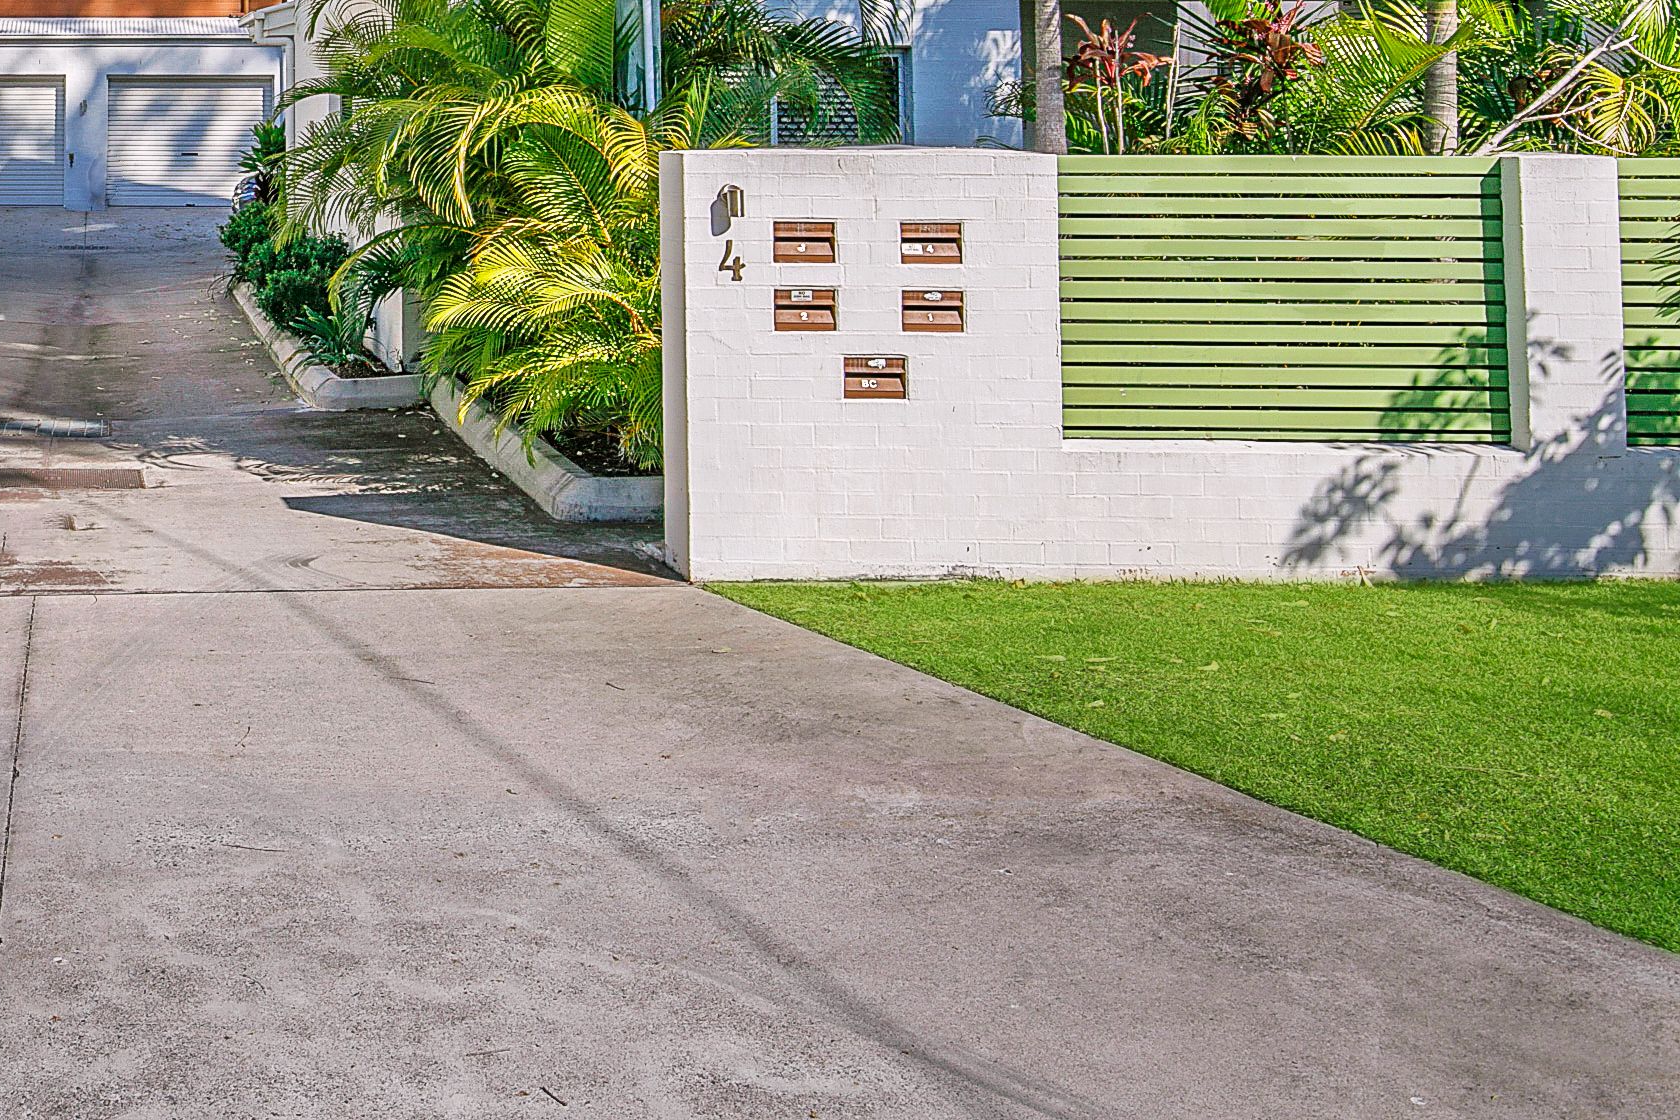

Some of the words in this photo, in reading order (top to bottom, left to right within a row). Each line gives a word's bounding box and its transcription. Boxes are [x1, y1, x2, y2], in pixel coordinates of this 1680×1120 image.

[926, 244, 935, 254] 4
[718, 239, 746, 282] 4
[800, 311, 809, 321] 2
[927, 312, 934, 322] 1
[861, 378, 878, 389] BC
